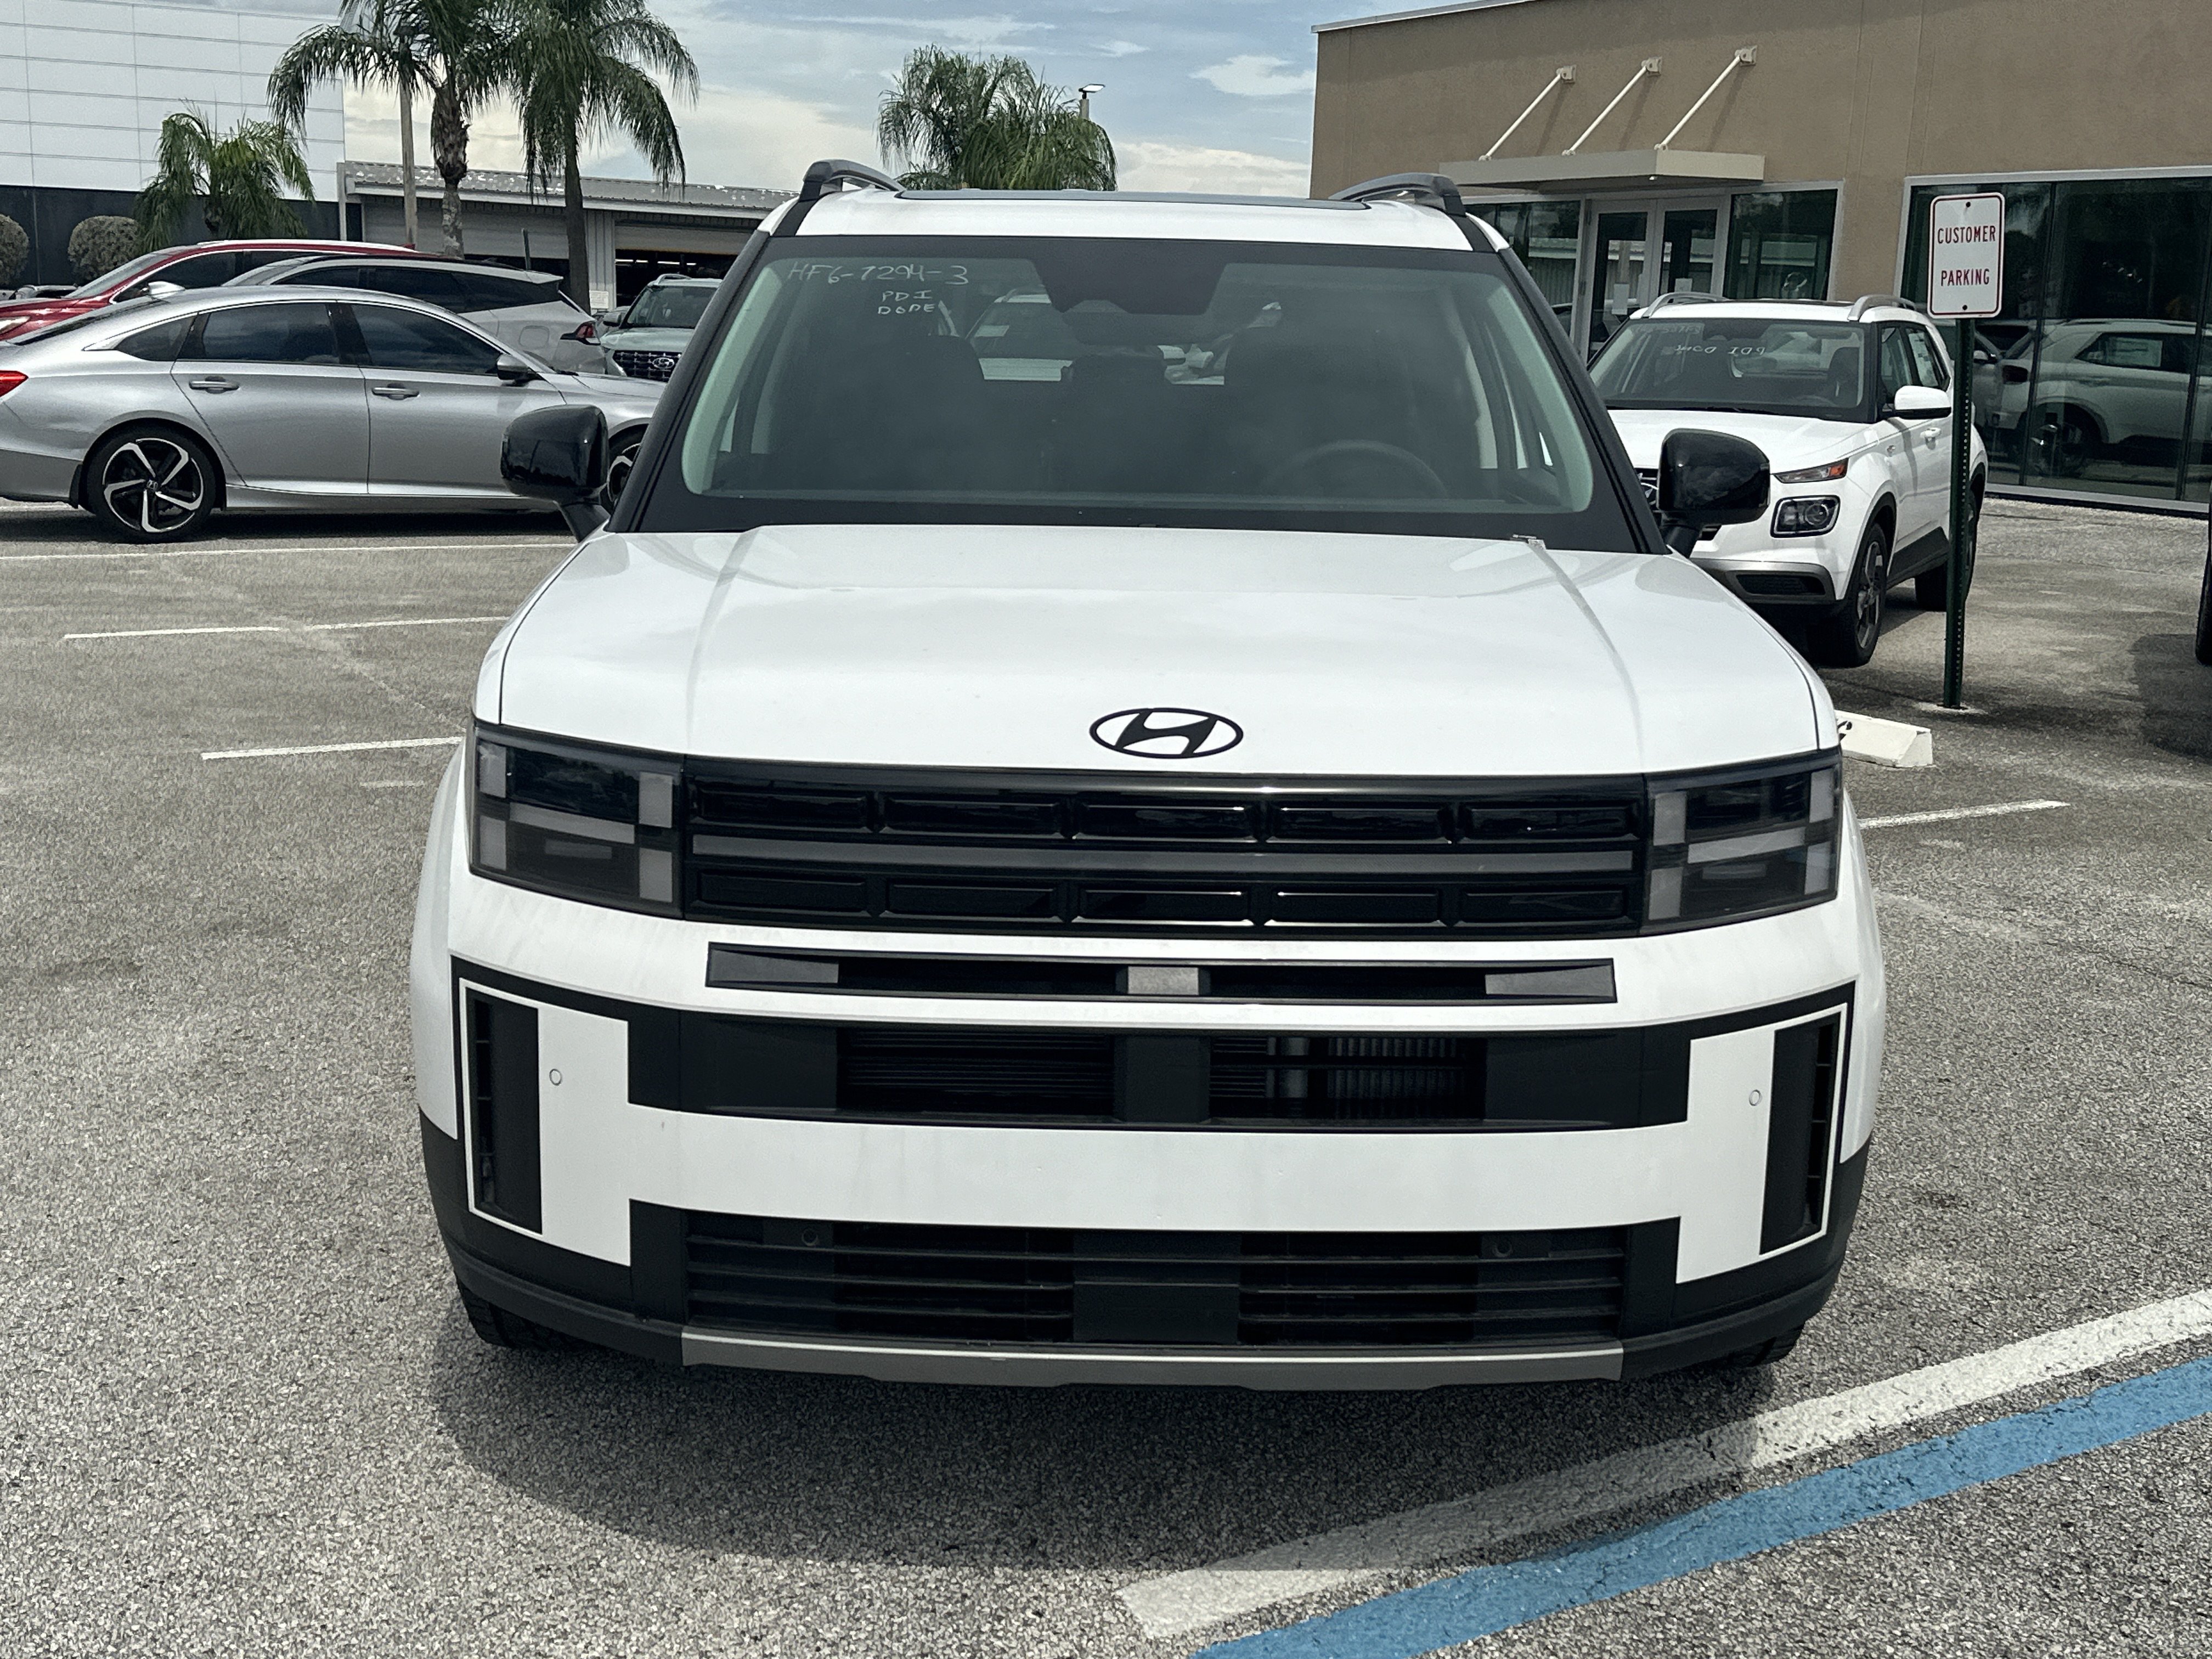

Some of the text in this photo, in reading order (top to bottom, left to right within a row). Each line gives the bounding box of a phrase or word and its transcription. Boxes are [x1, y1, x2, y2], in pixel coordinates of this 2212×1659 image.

[1937, 225, 1996, 244] CUSTOMER
[1940, 268, 1990, 286] PARKING
[882, 289, 932, 302] PDI
